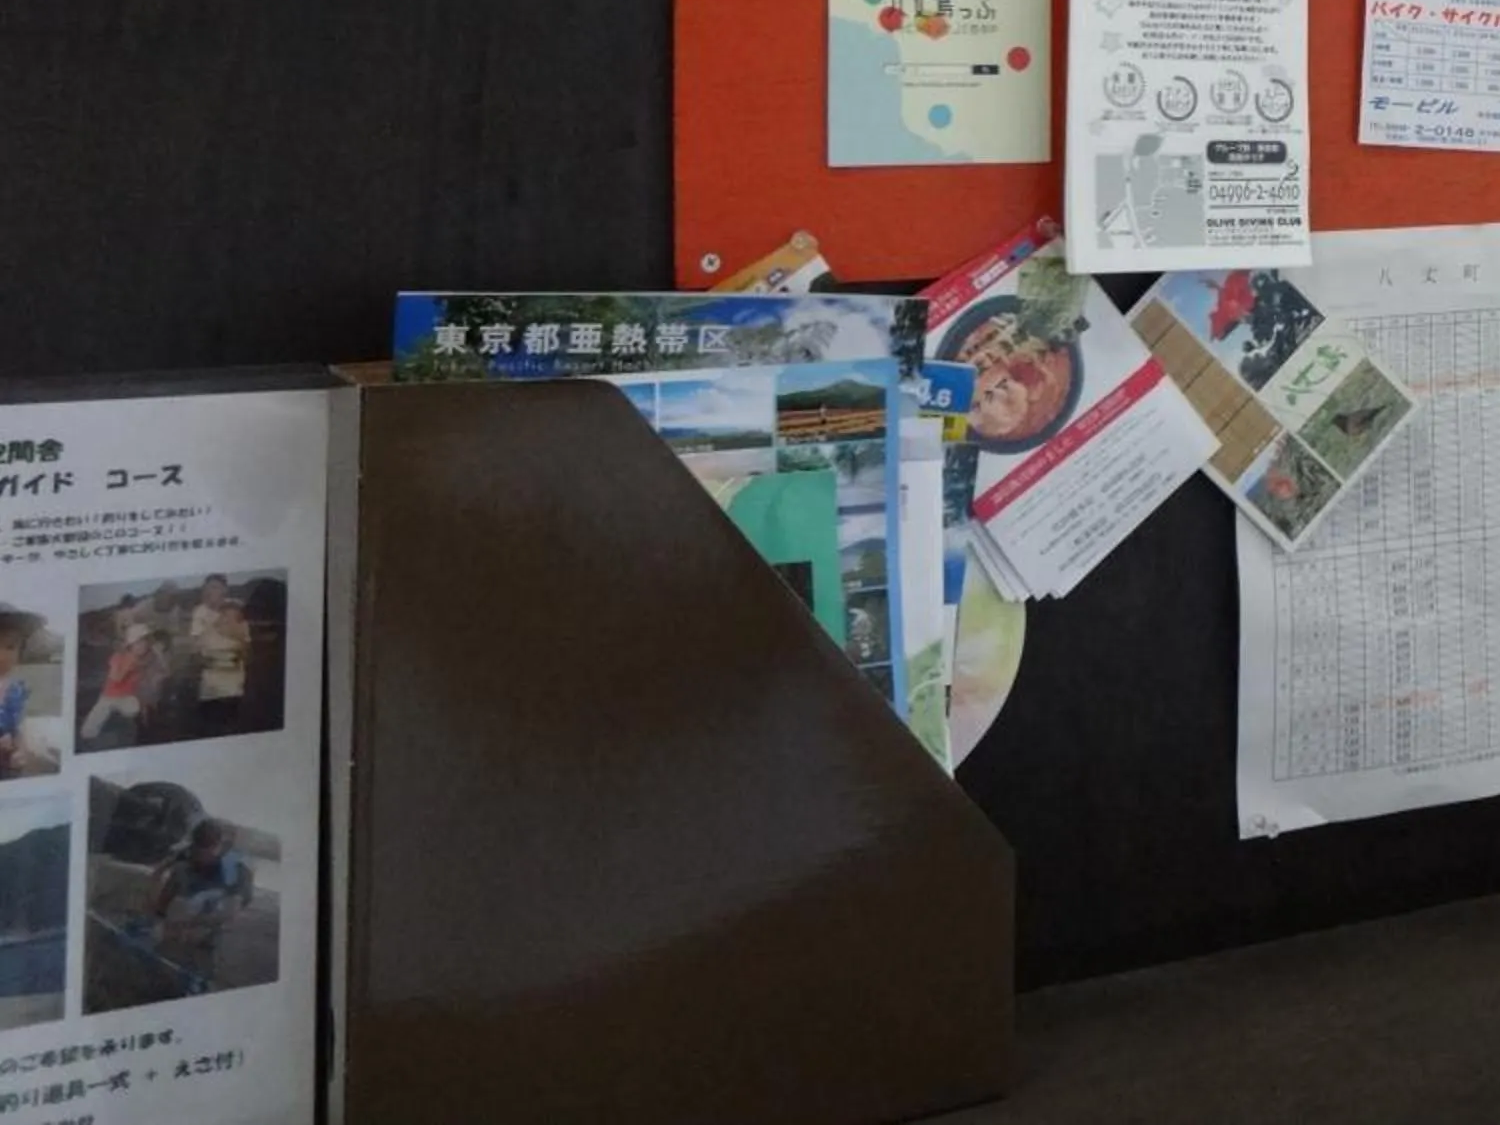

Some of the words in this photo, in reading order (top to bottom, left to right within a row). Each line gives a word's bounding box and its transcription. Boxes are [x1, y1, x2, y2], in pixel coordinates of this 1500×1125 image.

[432, 322, 732, 355] 東京都亜熱帯区
[106, 464, 184, 490] コース
